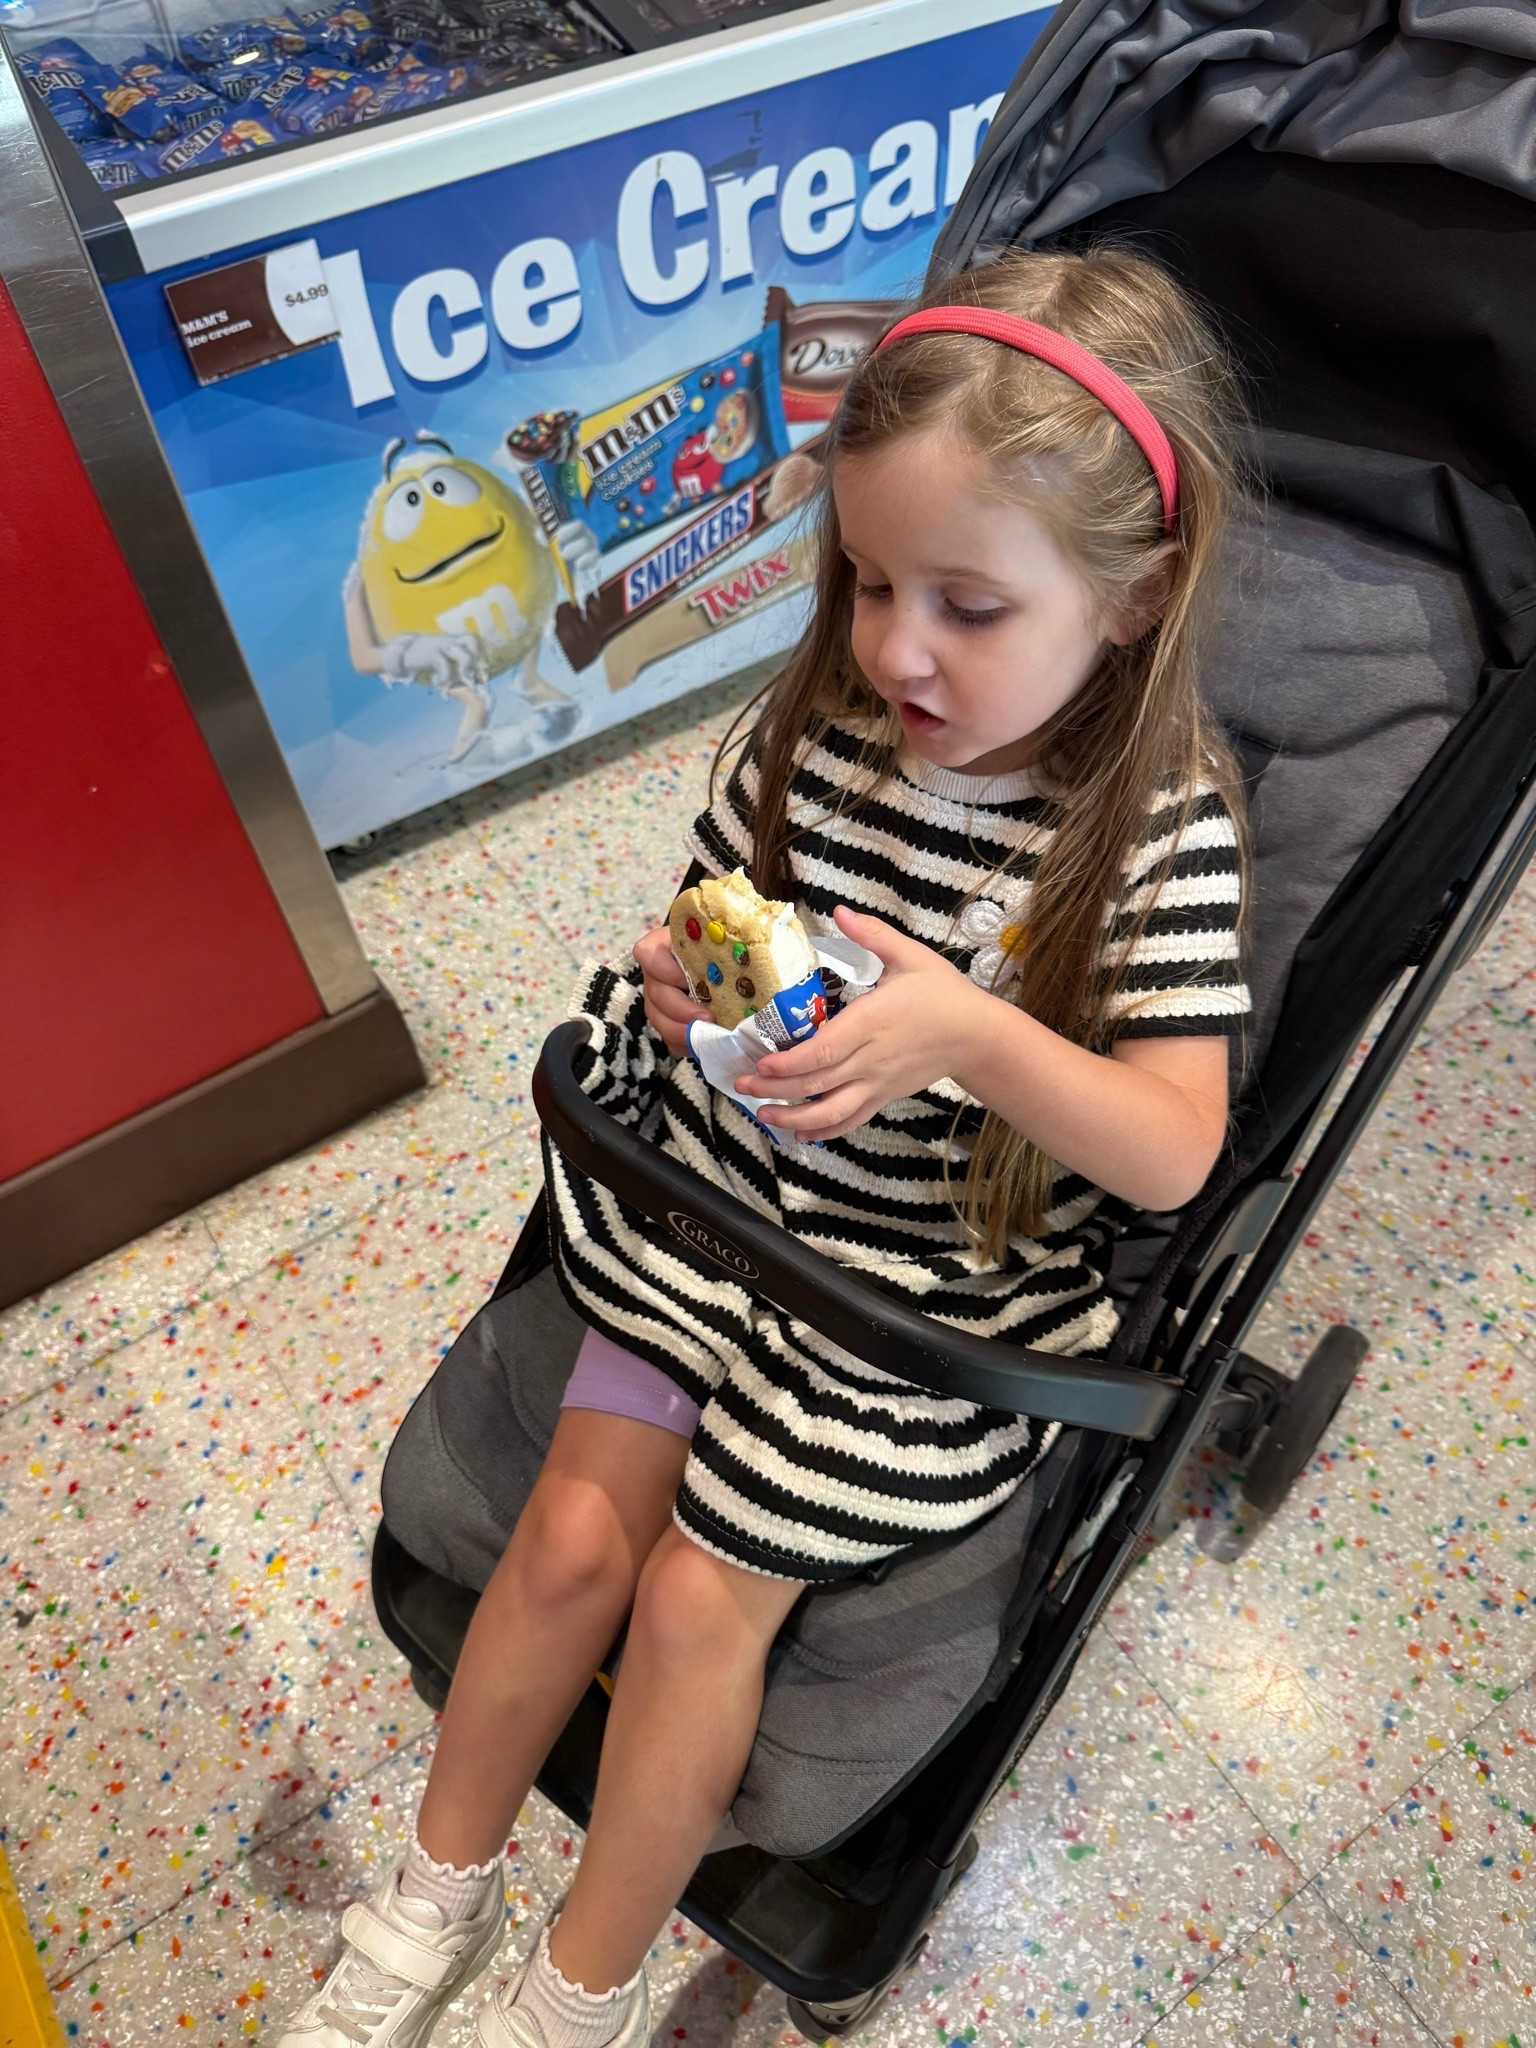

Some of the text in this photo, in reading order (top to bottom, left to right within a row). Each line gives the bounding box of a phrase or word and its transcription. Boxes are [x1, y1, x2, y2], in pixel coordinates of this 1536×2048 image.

[284, 283, 330, 308] $4.99
[184, 318, 253, 349] ice cream
[321, 237, 582, 409] Ice
[630, 492, 750, 606] SNICKERS
[681, 1219, 750, 1272] GRACO
